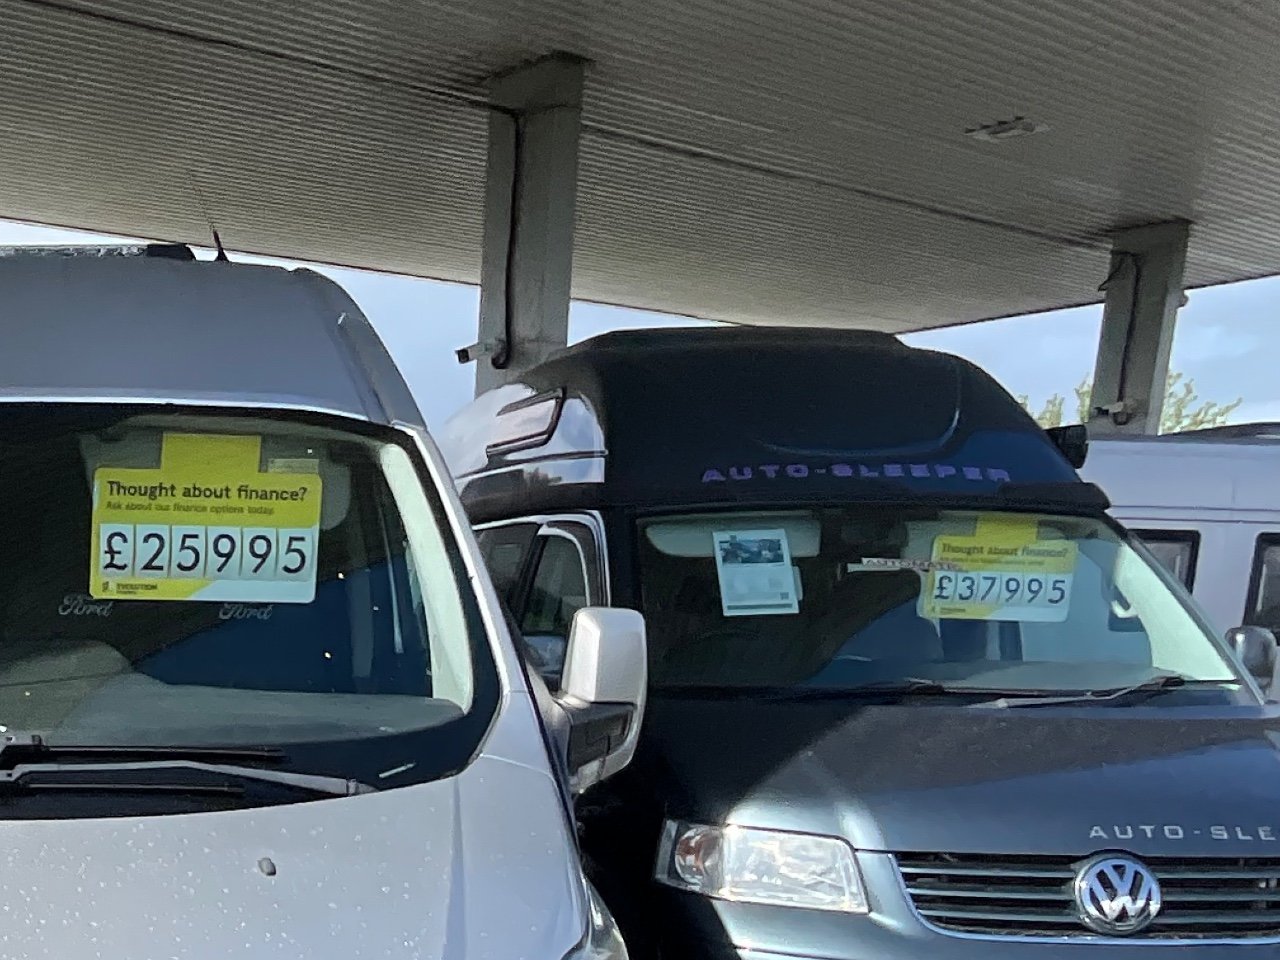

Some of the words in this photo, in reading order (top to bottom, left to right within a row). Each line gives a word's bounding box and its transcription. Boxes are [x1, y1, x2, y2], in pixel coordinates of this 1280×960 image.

[107, 480, 176, 501] Thought
[182, 483, 231, 500] about
[236, 484, 308, 502] finance?
[125, 502, 152, 512] about
[173, 503, 208, 514] finance
[210, 505, 244, 515] options
[103, 531, 308, 575] £25995
[942, 543, 984, 556] Thought
[987, 546, 1018, 556] about
[934, 575, 1066, 604] £37995
[219, 603, 273, 620] Ford
